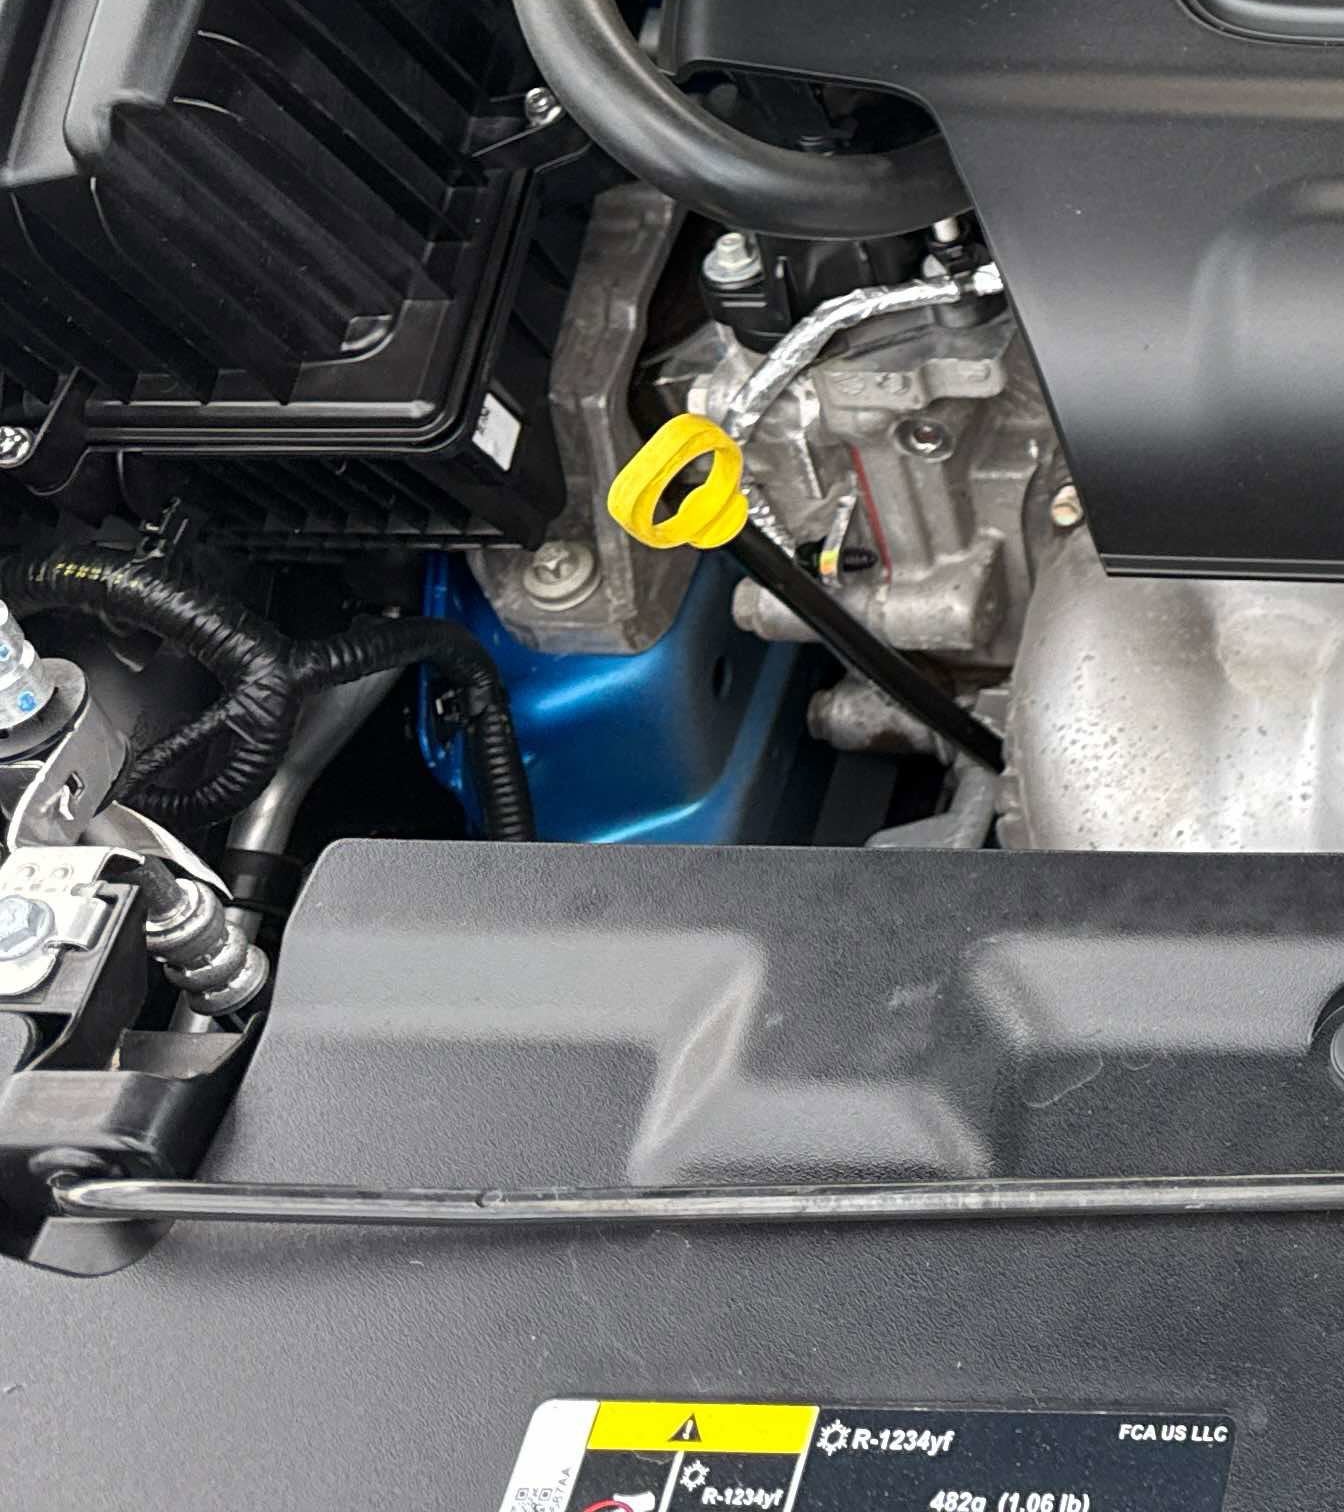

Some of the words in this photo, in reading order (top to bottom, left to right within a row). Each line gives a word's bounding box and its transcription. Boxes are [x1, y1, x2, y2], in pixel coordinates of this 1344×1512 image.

[851, 1428, 956, 1456] R-1234yf
[1118, 1423, 1156, 1440] FCA
[1160, 1424, 1187, 1441] US
[1190, 1425, 1229, 1443] LLC
[701, 1487, 785, 1510] R-1234yf
